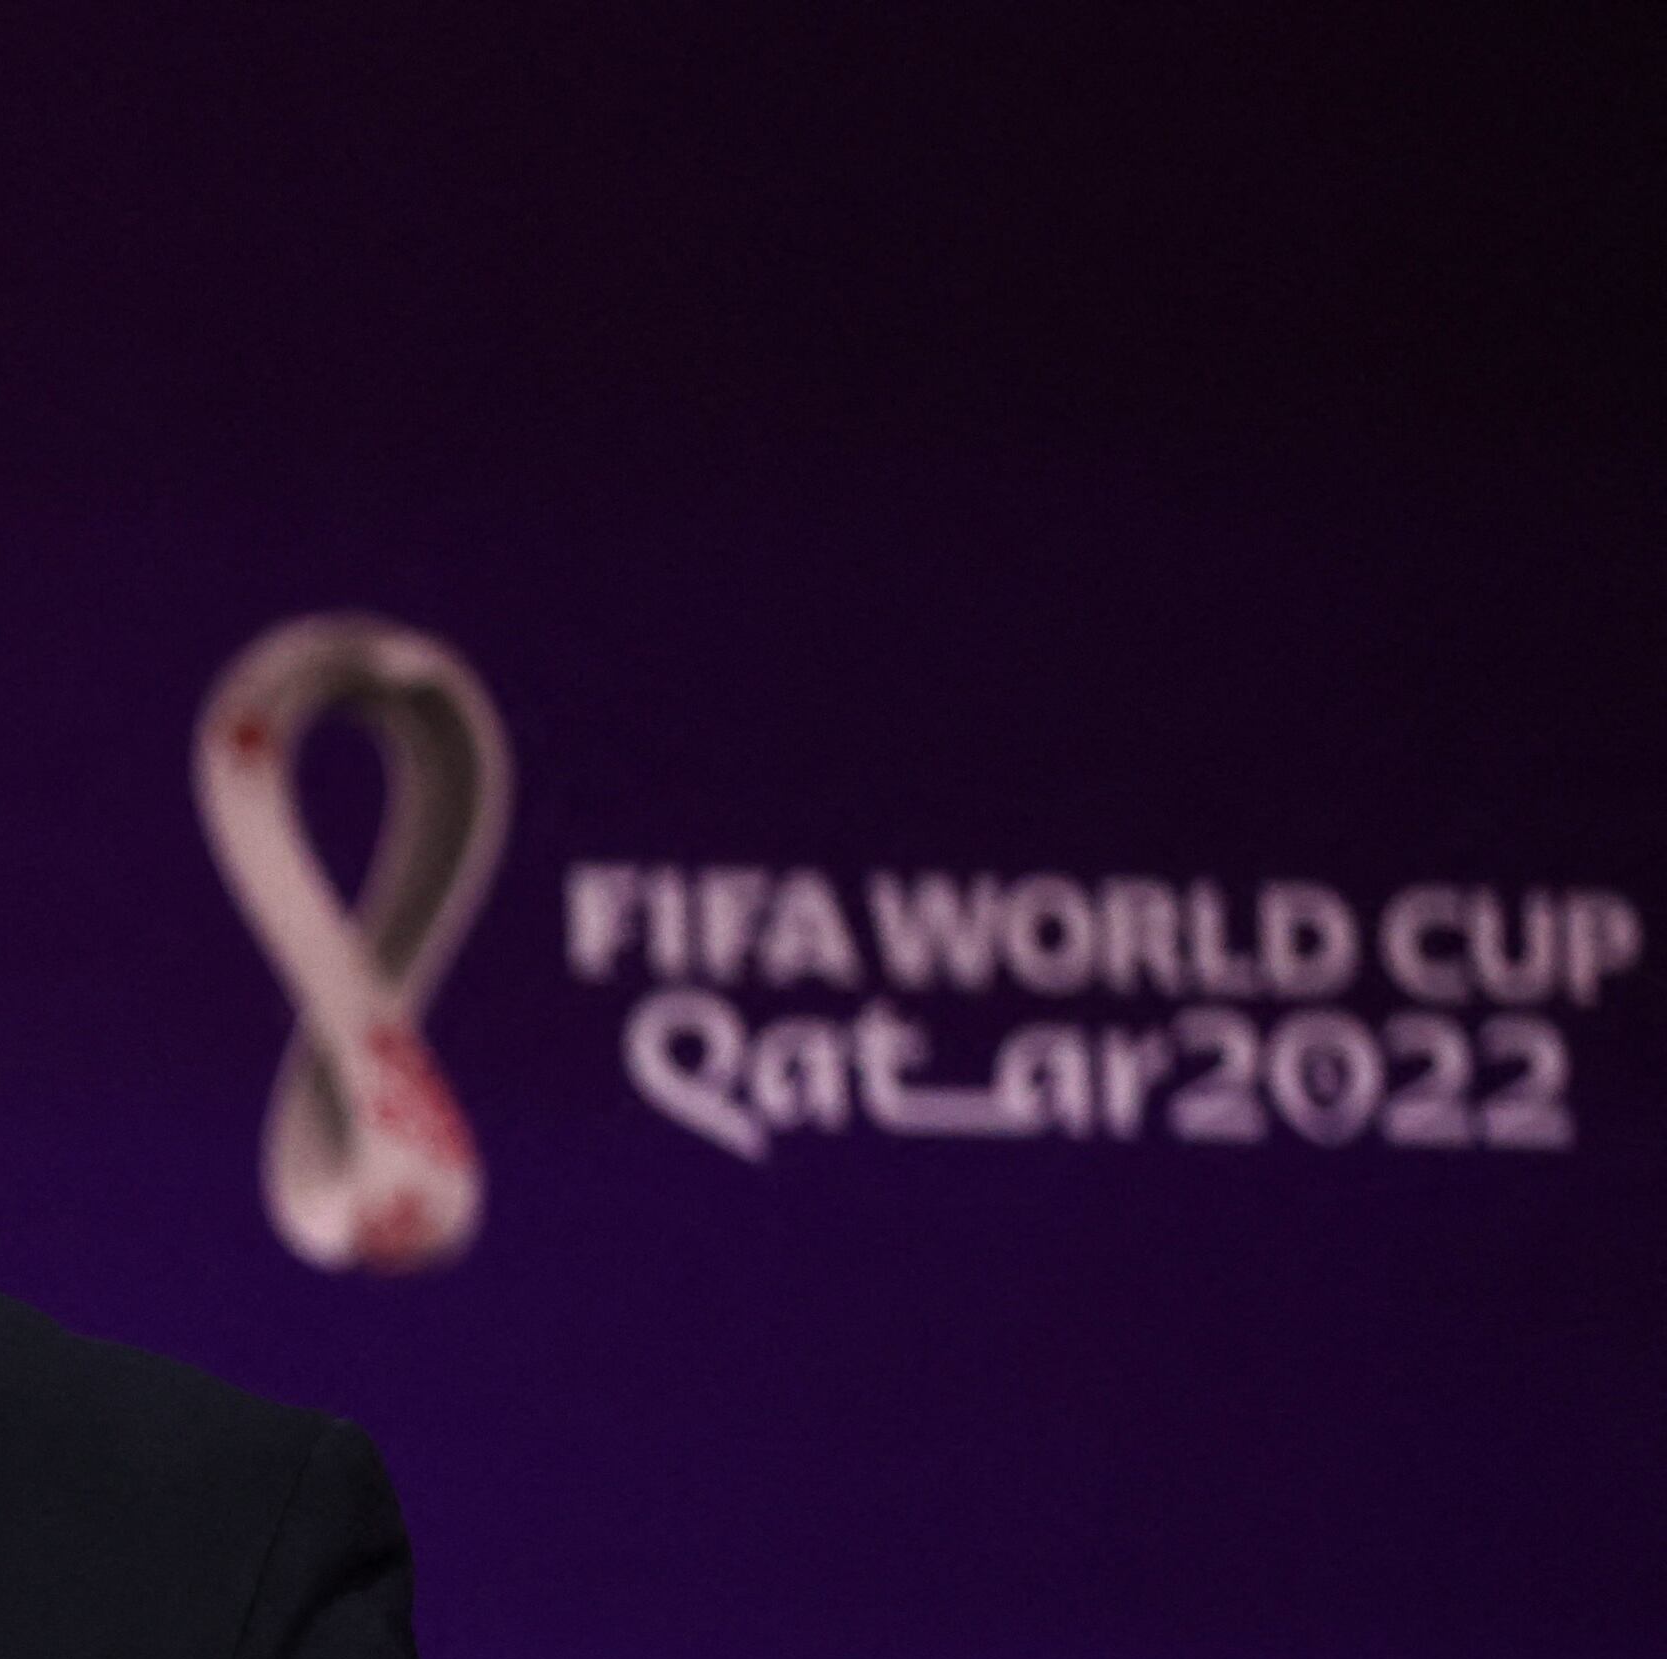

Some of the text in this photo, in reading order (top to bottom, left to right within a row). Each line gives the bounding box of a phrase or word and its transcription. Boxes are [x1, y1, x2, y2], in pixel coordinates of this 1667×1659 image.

[565, 863, 1639, 1000] FIFA WORLD CUP
[622, 986, 1569, 1158] Qatar2022
